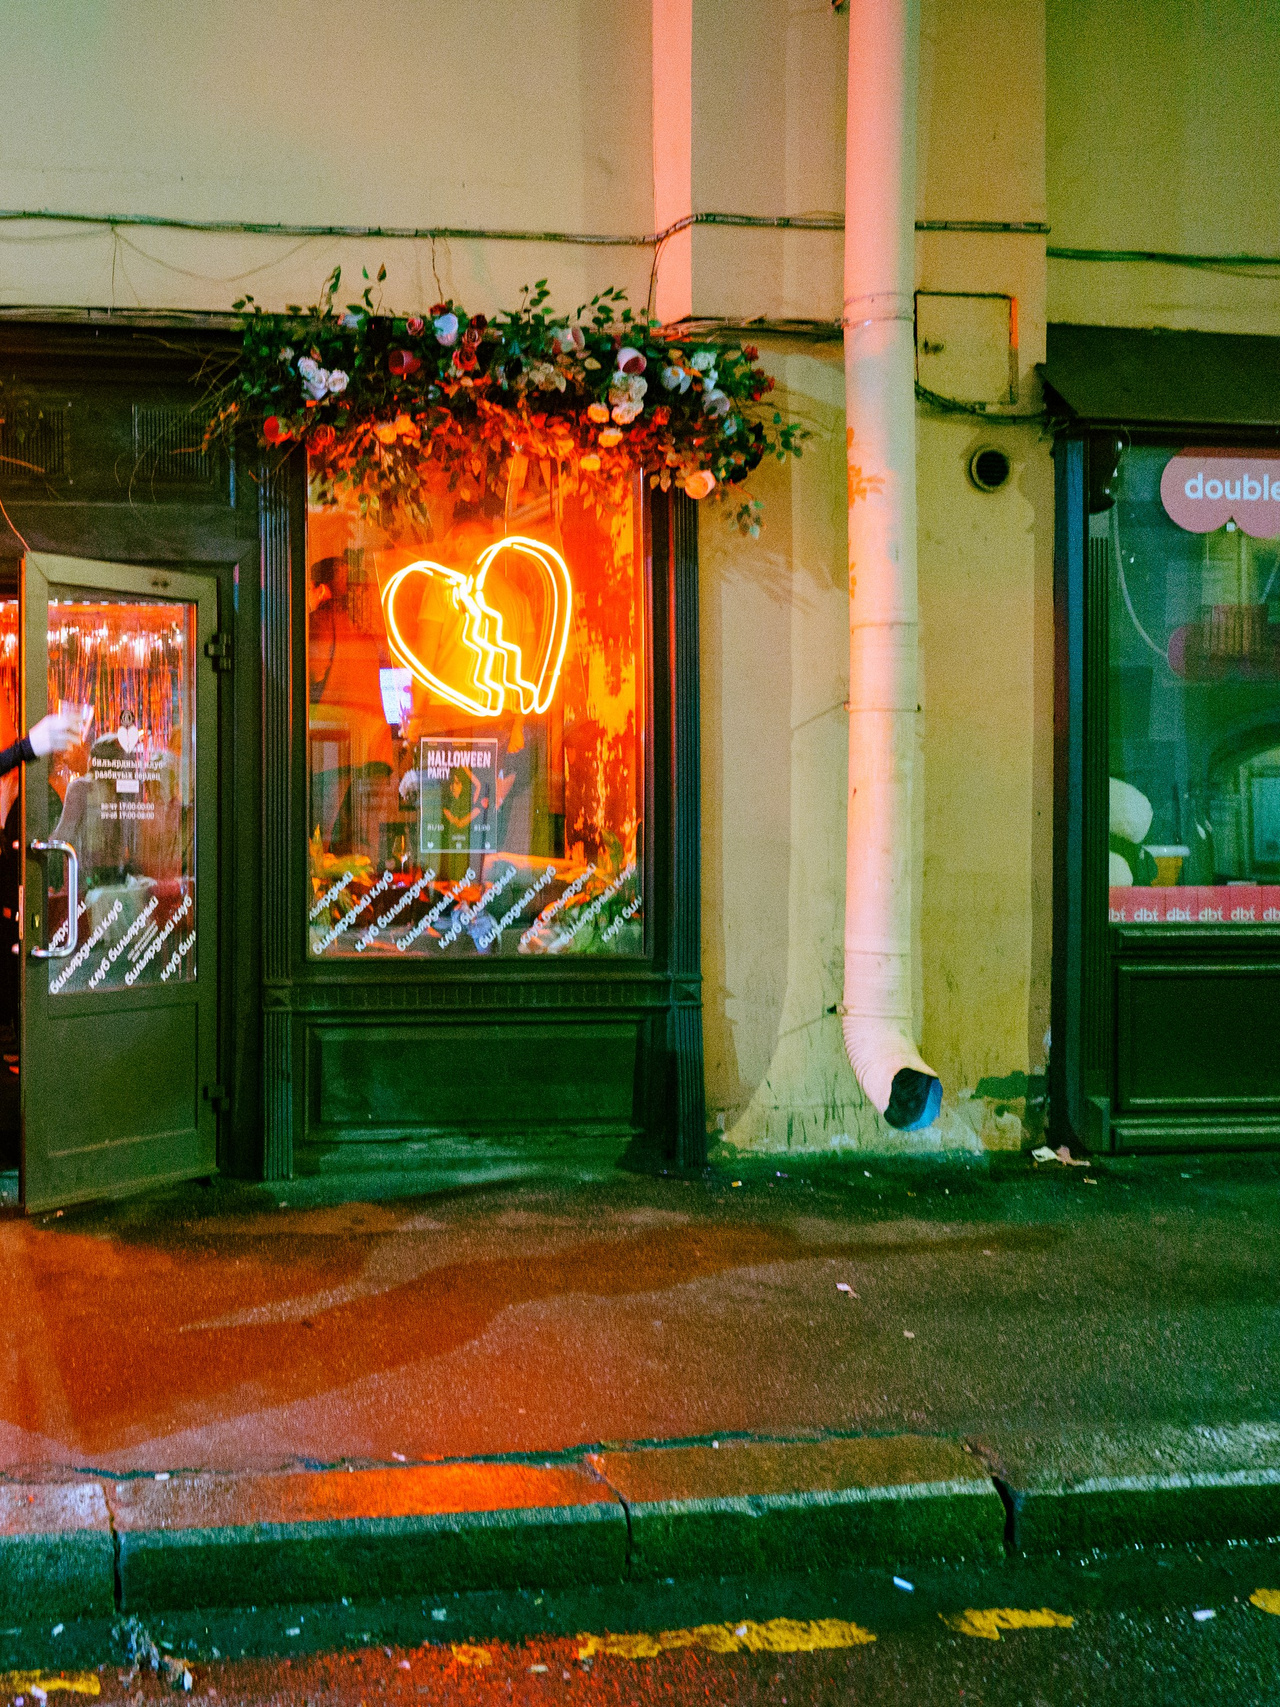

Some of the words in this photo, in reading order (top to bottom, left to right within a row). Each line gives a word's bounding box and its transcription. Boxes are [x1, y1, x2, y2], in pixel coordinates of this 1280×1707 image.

[427, 750, 491, 768] HALLOWEEN
[427, 767, 450, 780] PARTY
[50, 926, 103, 994] бильярдный
[102, 899, 122, 929] клуб
[88, 957, 110, 989] клуб
[108, 895, 159, 962] бильярдный
[125, 920, 174, 986] бильярдный
[173, 894, 192, 925] клуб
[313, 894, 371, 955] бильярдный
[370, 870, 393, 897] клуб
[355, 924, 379, 952] клуб
[377, 868, 436, 929] бильярдный
[396, 891, 455, 951] бильярдный
[452, 867, 476, 895] клуб
[438, 922, 461, 949] клуб
[460, 865, 517, 925] бильярдный
[478, 888, 535, 948] бильярдный
[533, 863, 557, 892] клуб
[520, 917, 543, 945] клуб
[601, 915, 624, 943] клуб
[1109, 906, 1126, 922] bt
[1133, 904, 1159, 922] dbt
[1166, 904, 1191, 922] dbt
[1198, 904, 1223, 922] dbt
[1230, 904, 1256, 922] dbt
[1262, 906, 1280, 922] db
[160, 951, 181, 982] клуб
